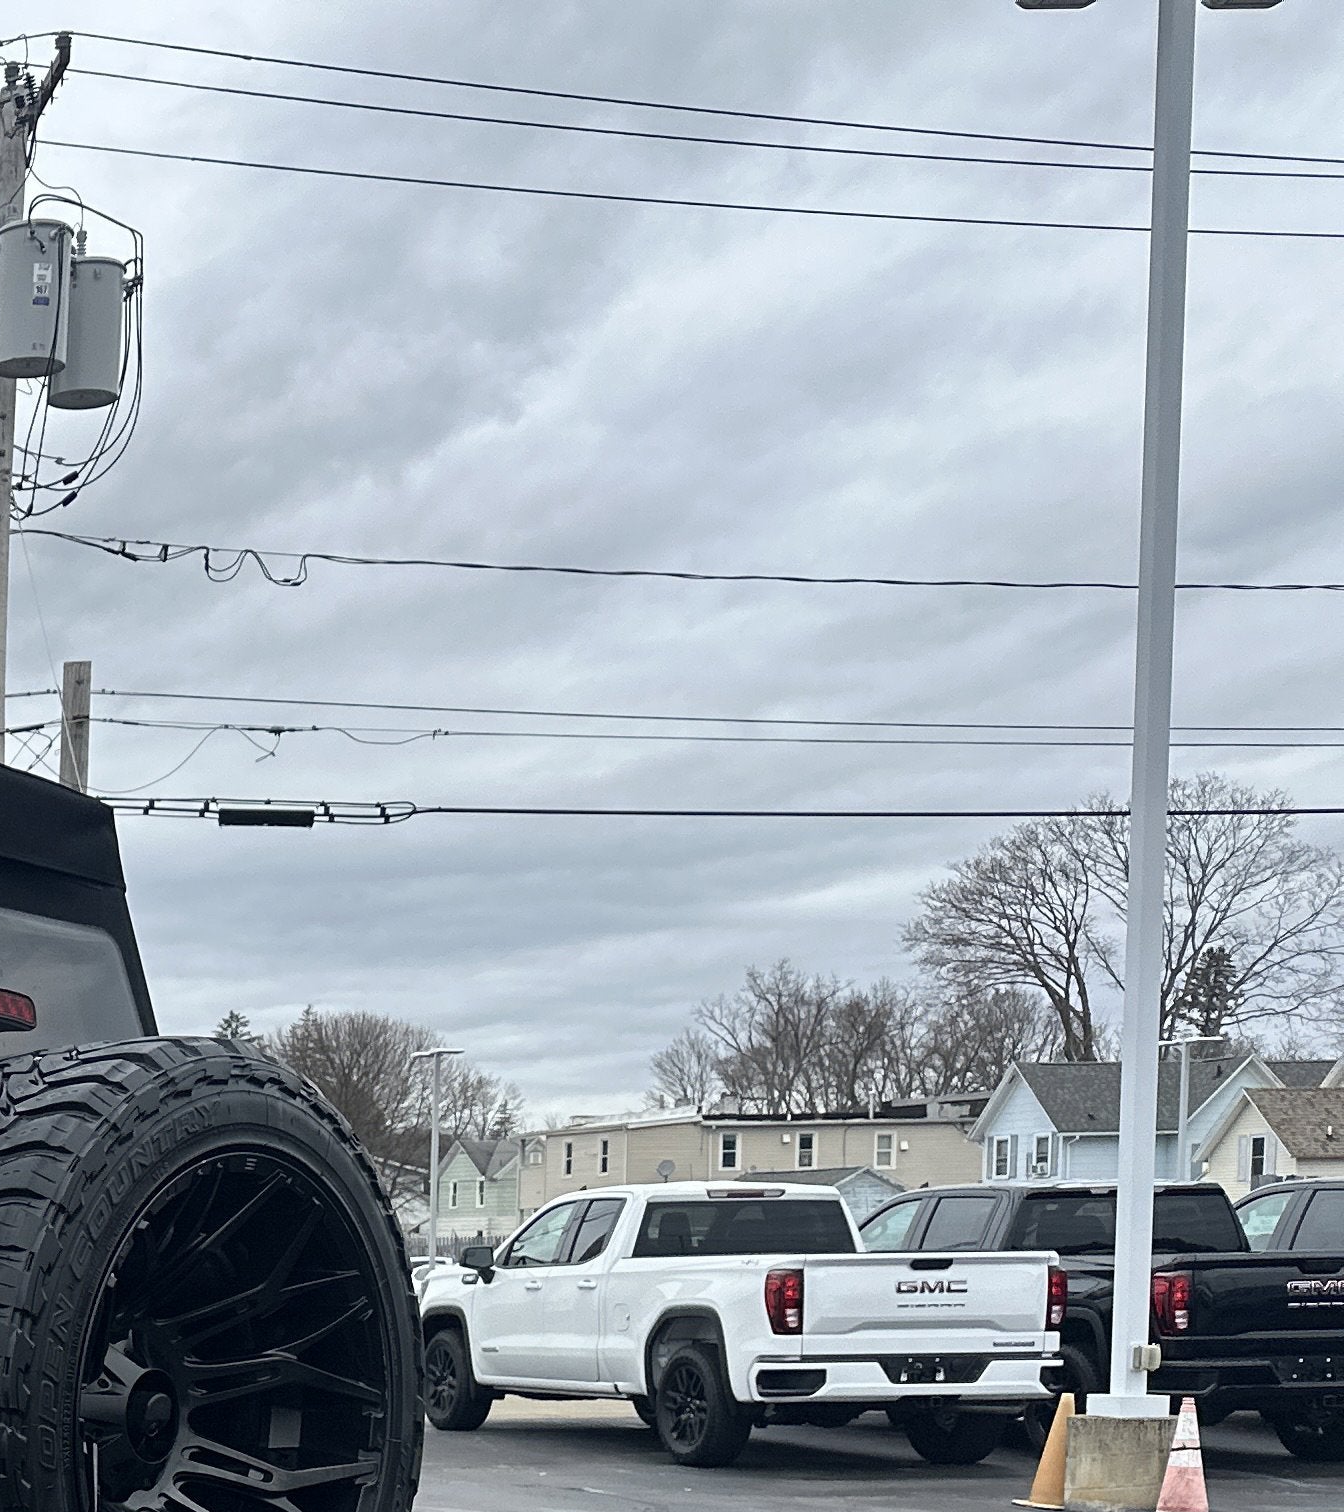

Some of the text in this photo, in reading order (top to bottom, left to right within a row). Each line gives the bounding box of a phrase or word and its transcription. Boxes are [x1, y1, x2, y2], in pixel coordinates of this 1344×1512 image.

[69, 1097, 221, 1281] COUNTRY
[895, 1280, 968, 1294] GMC
[1286, 1280, 1344, 1296] GM
